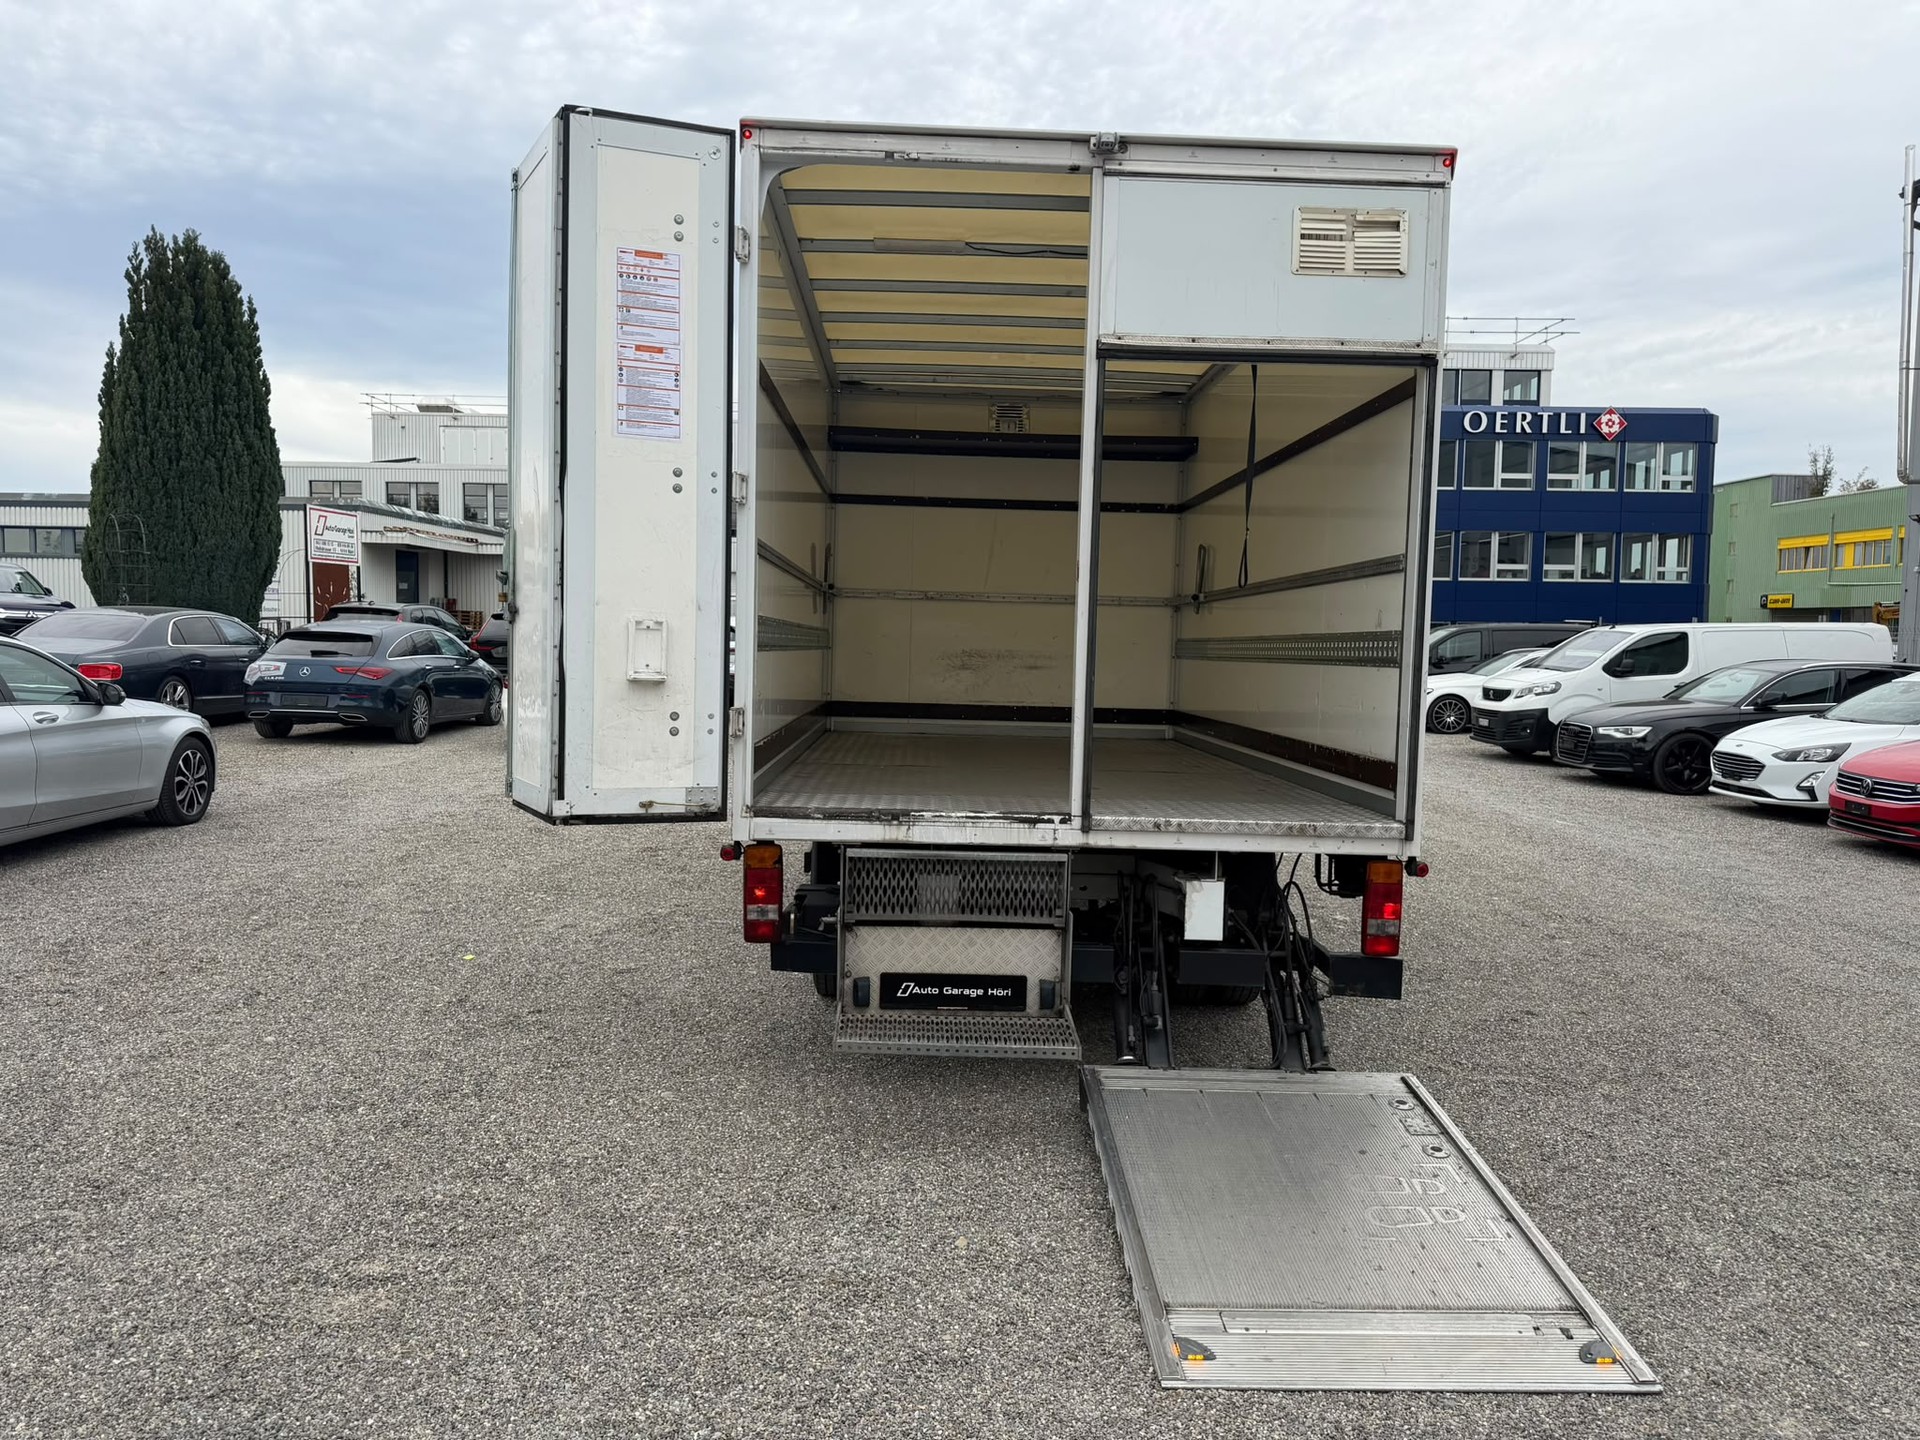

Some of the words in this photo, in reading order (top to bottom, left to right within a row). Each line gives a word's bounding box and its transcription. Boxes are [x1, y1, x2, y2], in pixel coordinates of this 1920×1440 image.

[1463, 410, 1587, 434] OERTLI
[912, 986, 940, 995] Auto
[943, 986, 985, 998] Garage
[987, 987, 1012, 997] Höri
